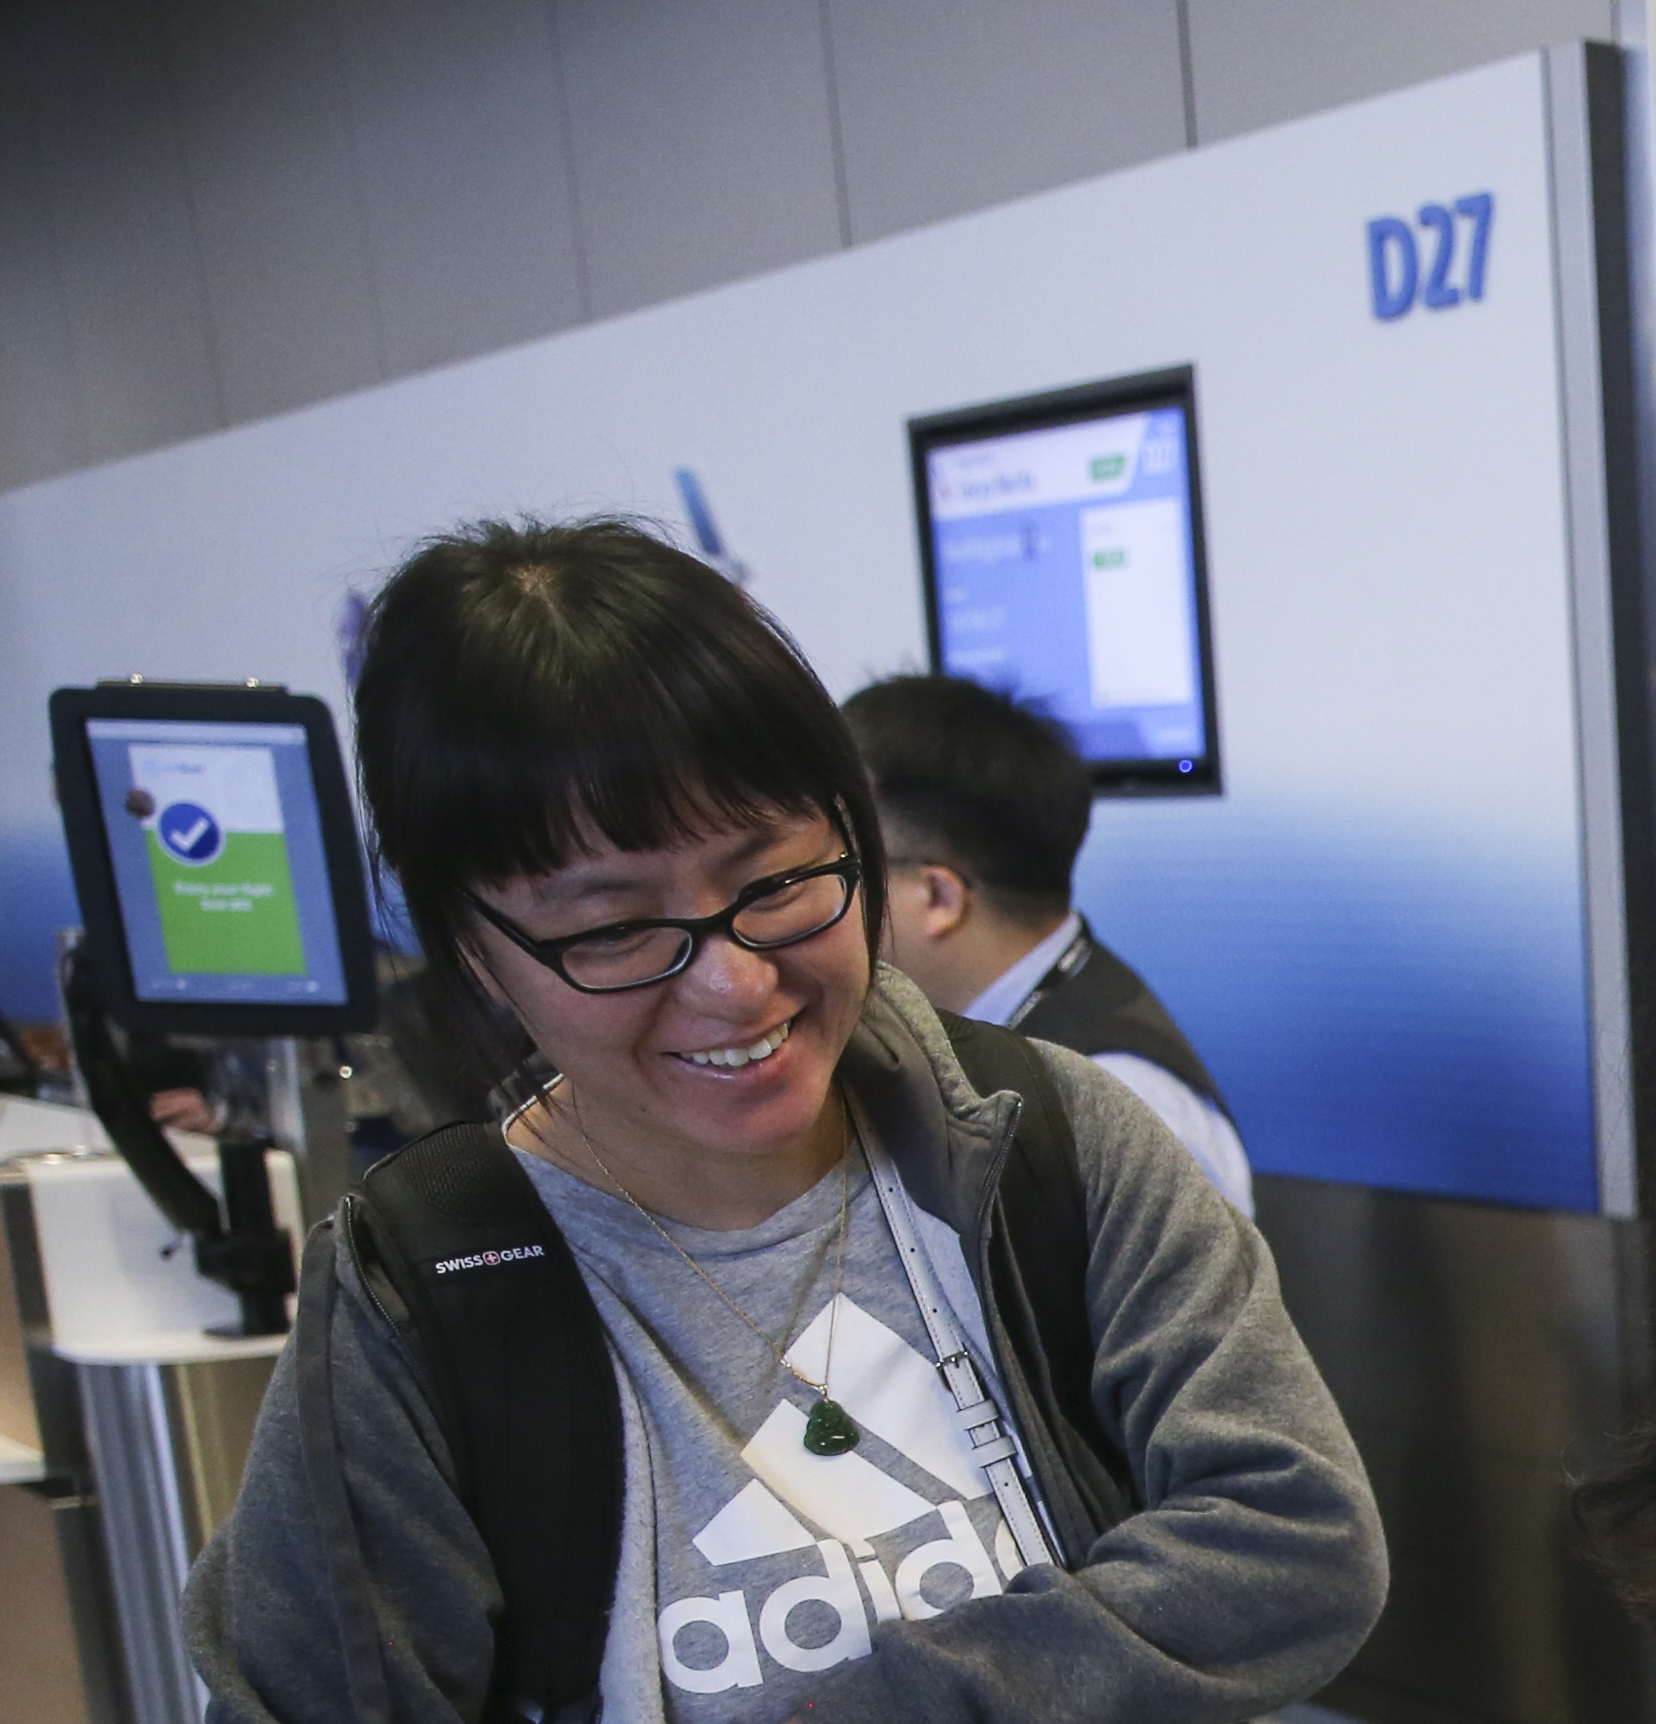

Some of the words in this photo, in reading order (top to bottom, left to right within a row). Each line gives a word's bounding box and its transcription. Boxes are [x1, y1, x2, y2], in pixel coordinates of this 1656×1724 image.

[1369, 194, 1491, 320] D27
[435, 1255, 484, 1274] SWISS
[500, 1245, 545, 1261] GEAR
